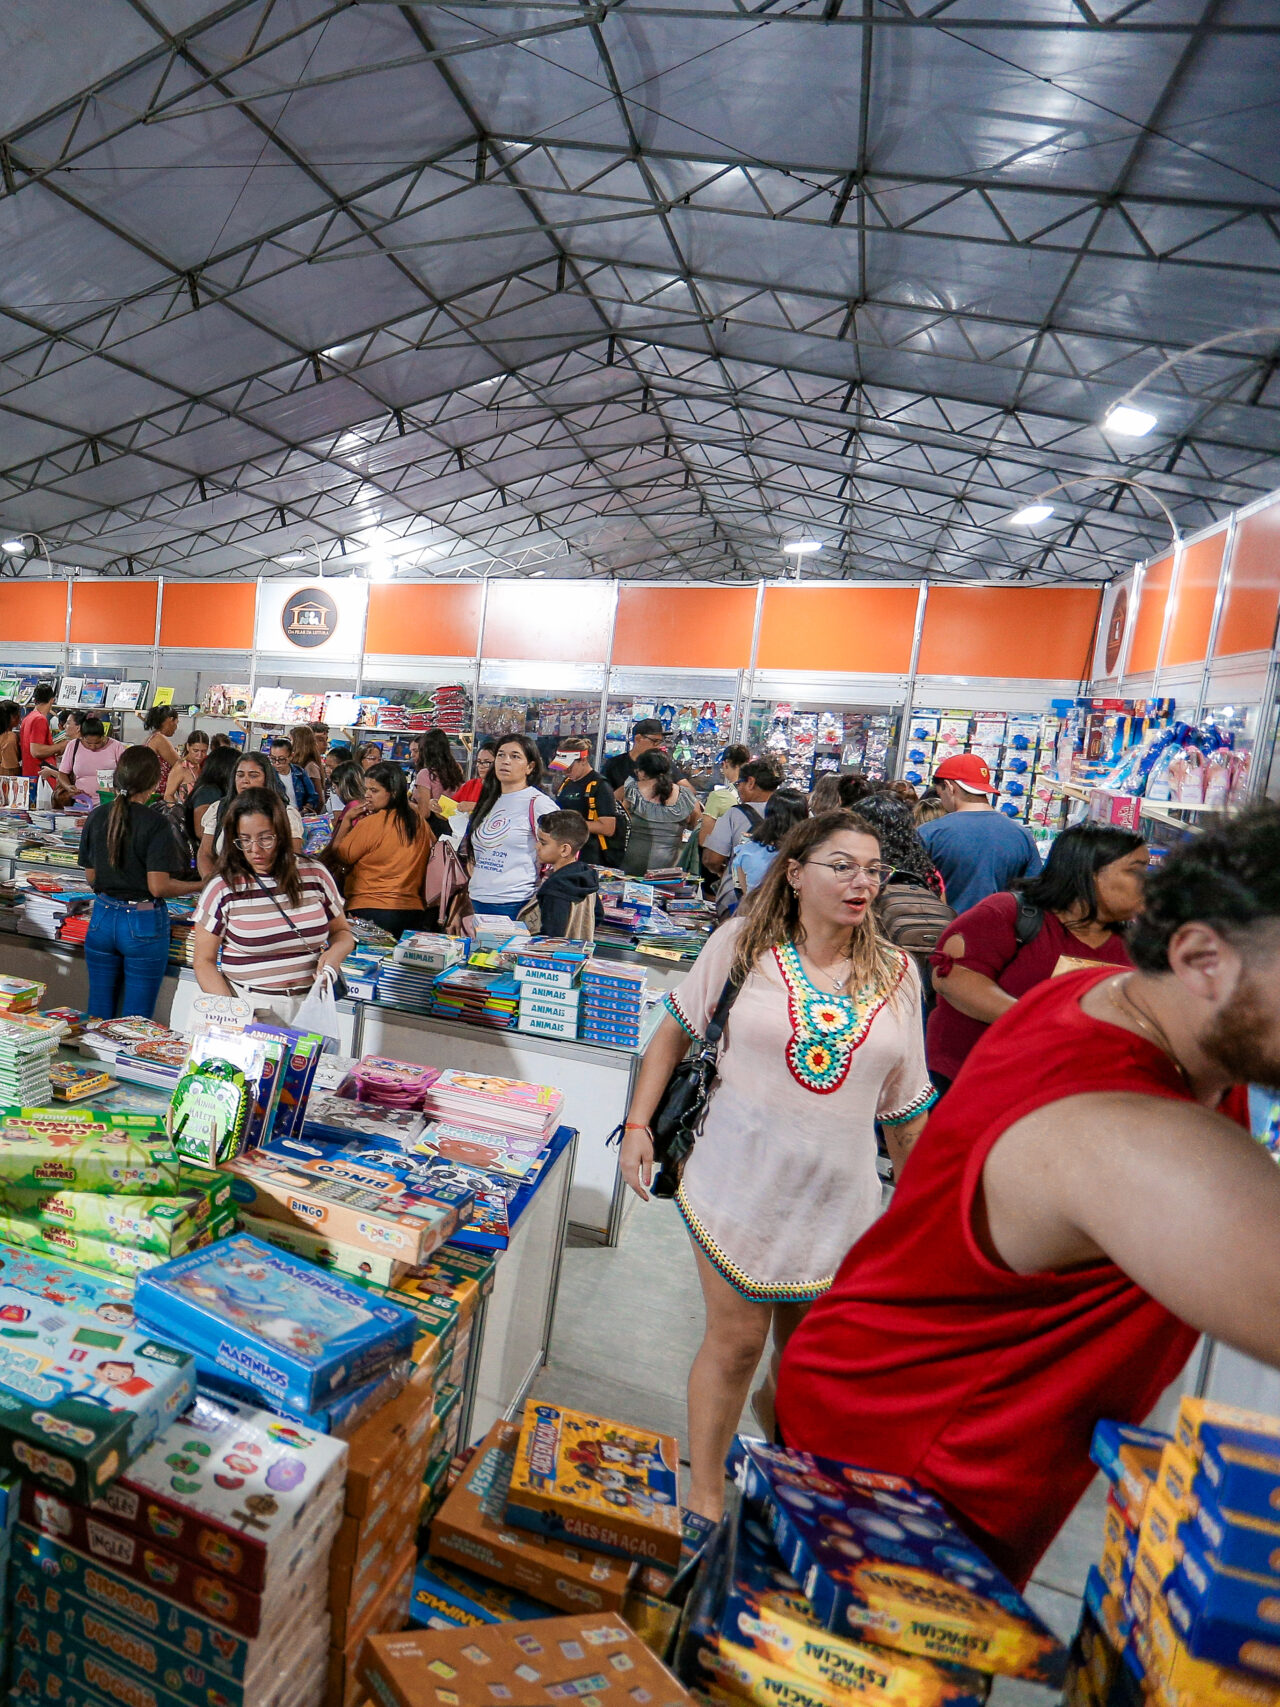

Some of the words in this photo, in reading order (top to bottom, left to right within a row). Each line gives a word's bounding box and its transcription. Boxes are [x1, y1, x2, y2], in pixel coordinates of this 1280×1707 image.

[492, 850, 508, 858] 2024
[403, 951, 434, 963] ANIMAIS
[525, 970, 559, 982] ANIMAIS
[532, 987, 566, 1000] ANIMAIS
[531, 1004, 565, 1017] ANIMAIS
[530, 1020, 564, 1032] ANIMAIS
[251, 1030, 289, 1044] ANIMAIS
[6, 1119, 106, 1132] PALAVRAS
[43, 1162, 63, 1171] CAÇA
[35, 1168, 74, 1180] PALAVRAS
[317, 1165, 391, 1189] BINGO
[40, 1201, 73, 1218] PALAVRAS
[292, 1200, 323, 1218] BINGO
[43, 1232, 76, 1248] PALAVRAS
[266, 1258, 368, 1307] MARINHOS
[219, 1340, 289, 1388] MARINHOS
[600, 1527, 619, 1546] EM
[909, 1622, 990, 1652] ESPACIAL
[804, 1642, 888, 1690] ESPACIAL
